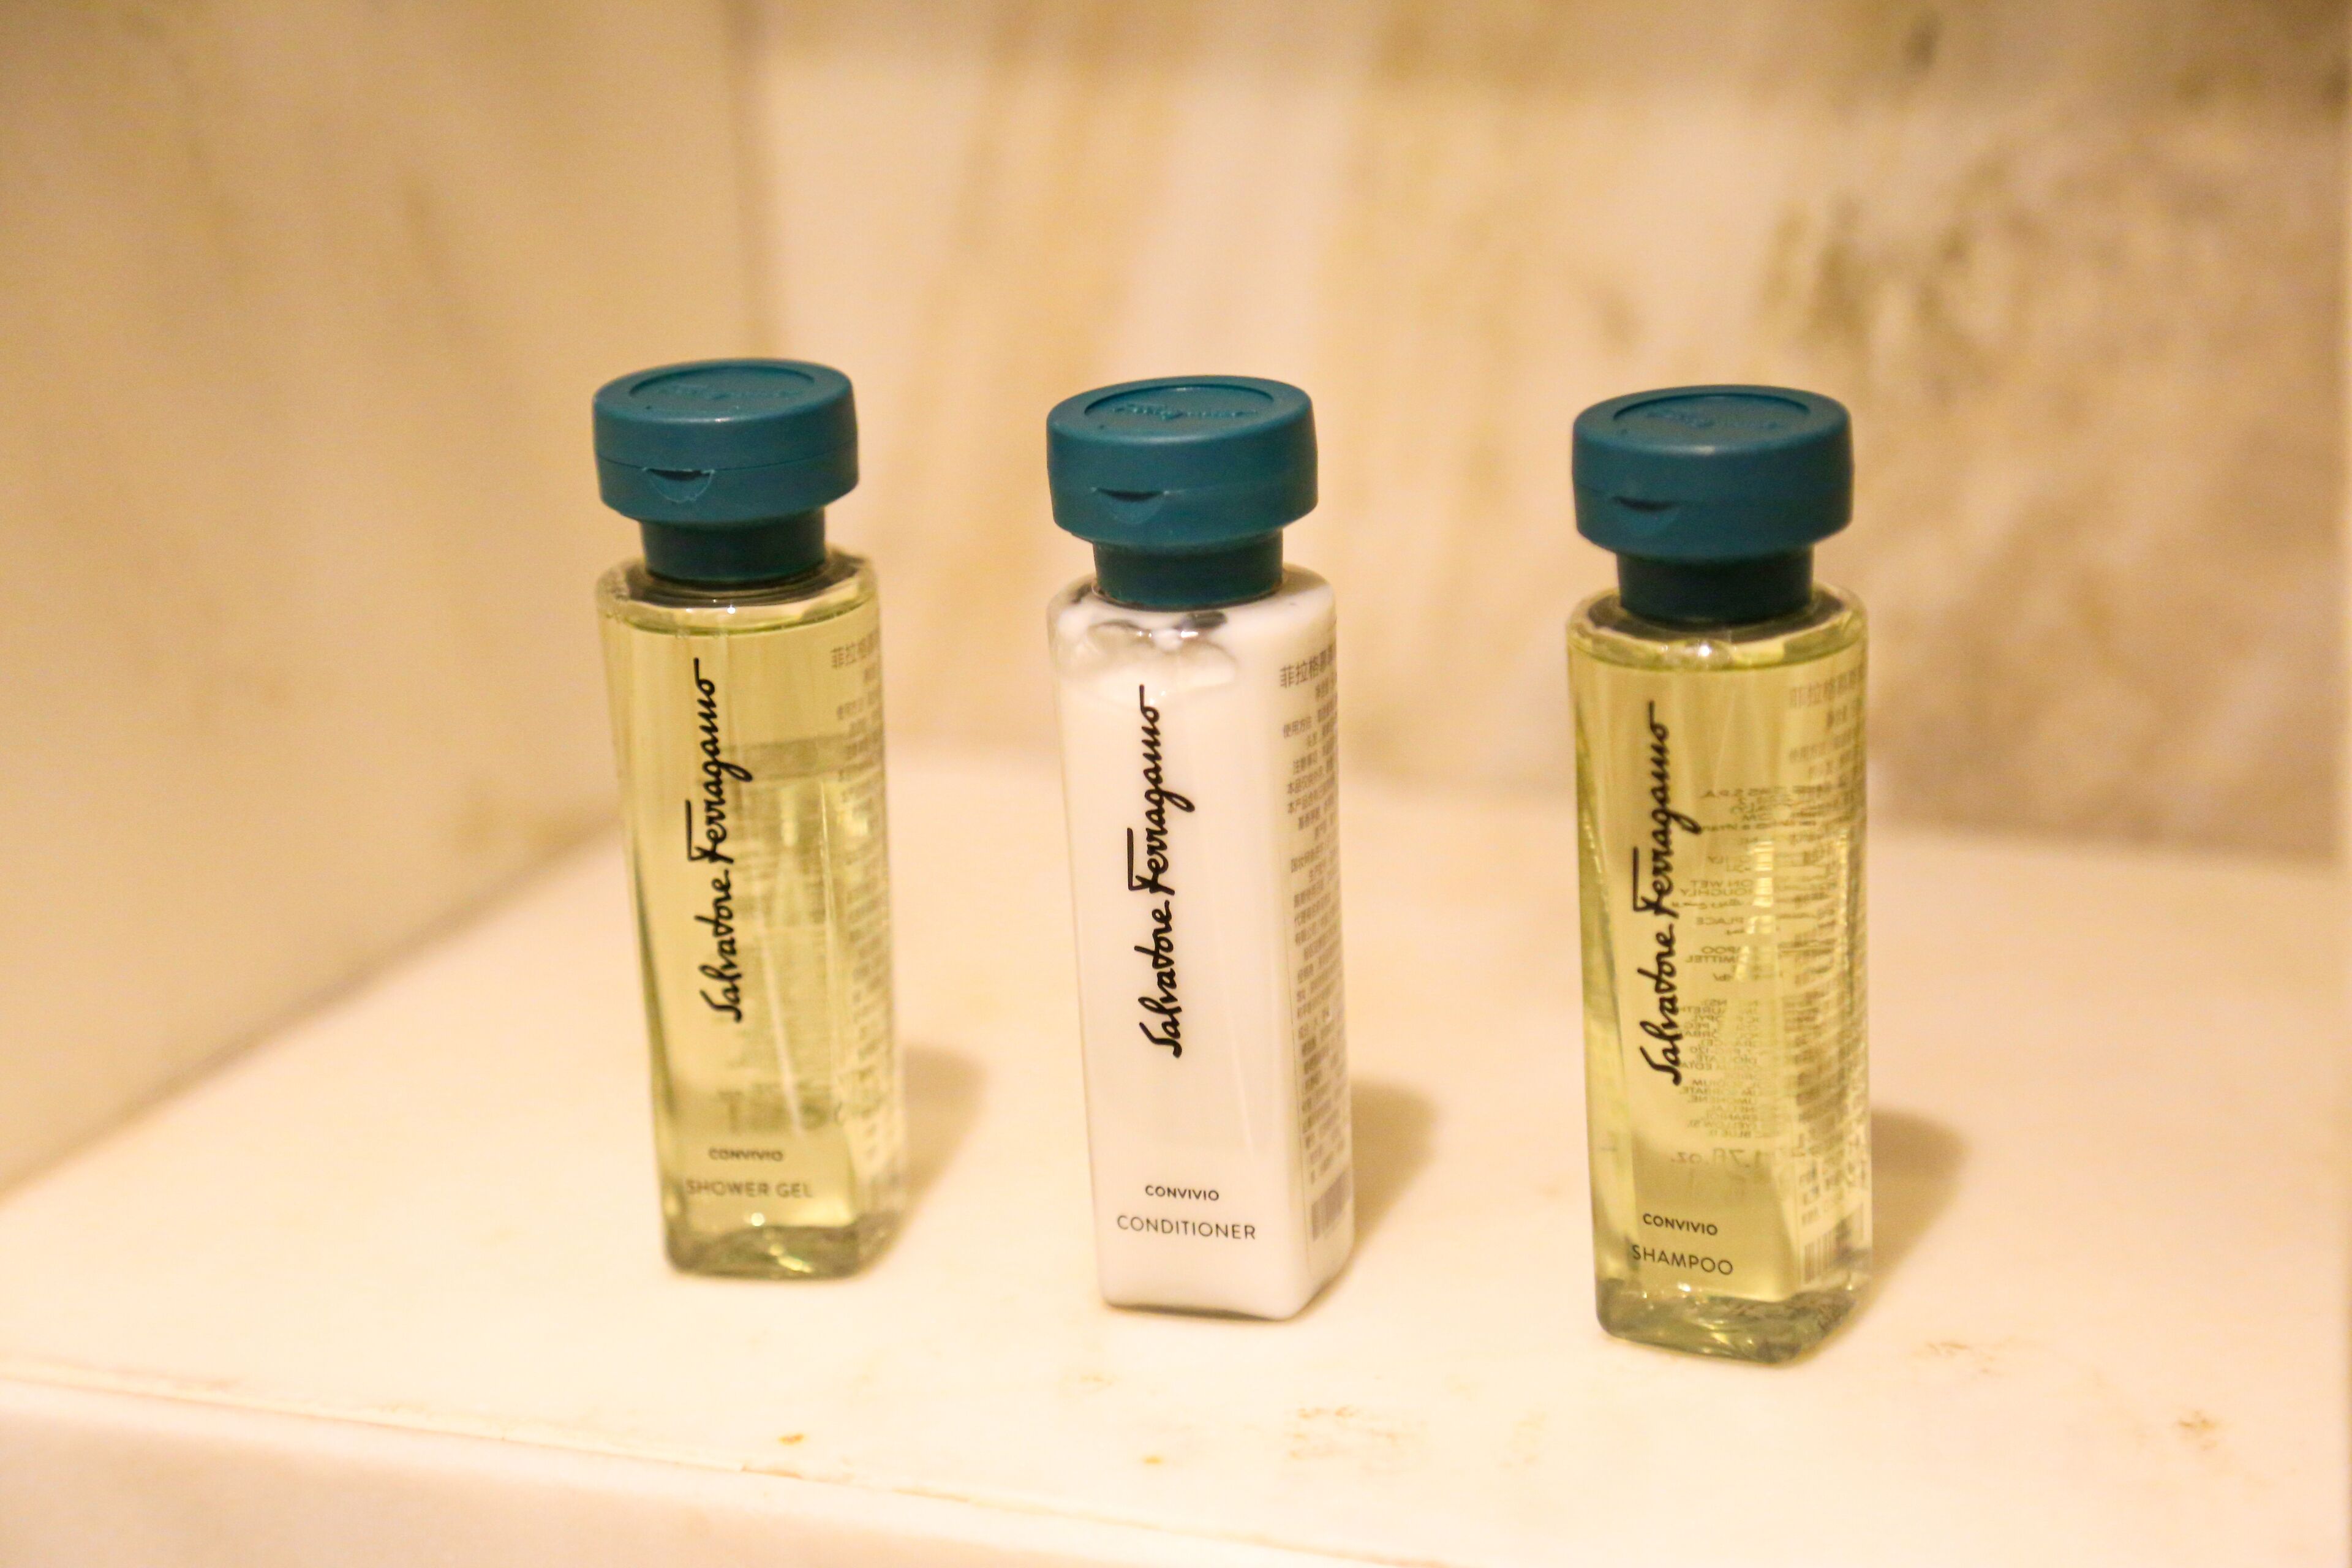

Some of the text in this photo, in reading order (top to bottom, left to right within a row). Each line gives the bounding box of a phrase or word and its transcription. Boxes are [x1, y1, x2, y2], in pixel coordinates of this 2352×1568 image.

[685, 657, 753, 1023] Salvatore Ferragamo
[1126, 684, 1196, 1059] Salvatore Ferragamo
[1632, 701, 1703, 1087] Salvatore Ferragamo
[708, 1147, 785, 1162] CONVIVIO
[685, 1178, 813, 1199] SHOWER GEL
[1144, 1184, 1220, 1202] CONVIVIO
[1116, 1214, 1256, 1240] CONDITIONER
[1642, 1213, 1719, 1236] CONVIVIO
[1631, 1244, 1733, 1276] SHAMPOO
